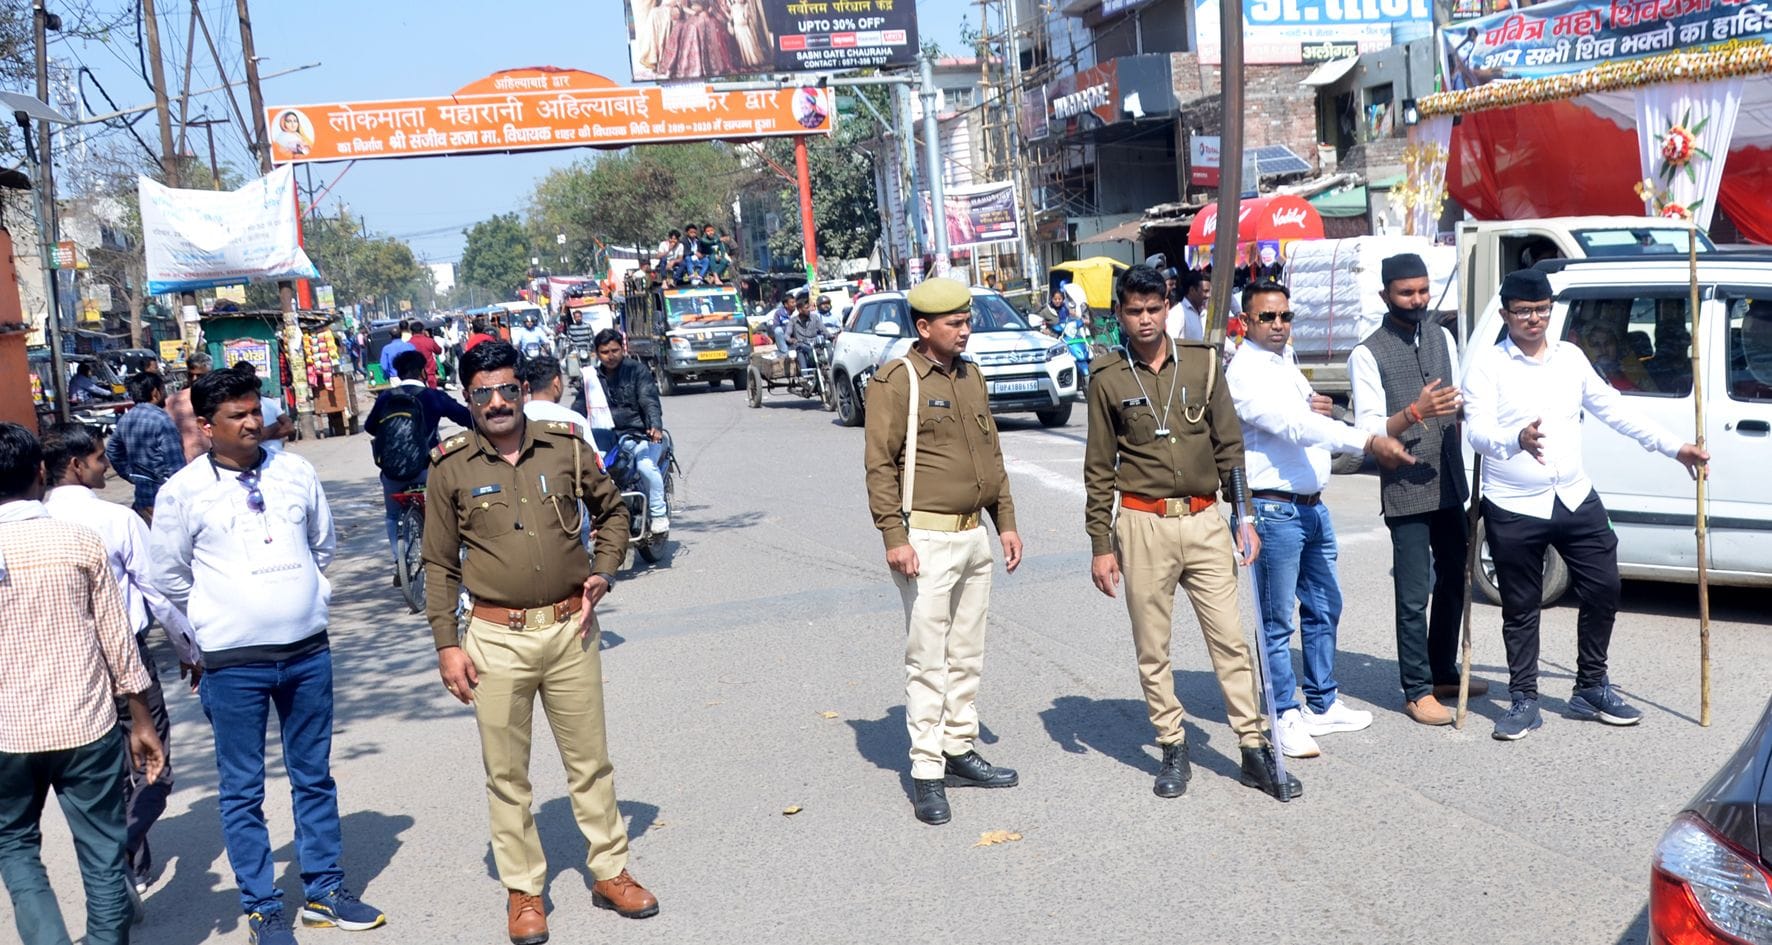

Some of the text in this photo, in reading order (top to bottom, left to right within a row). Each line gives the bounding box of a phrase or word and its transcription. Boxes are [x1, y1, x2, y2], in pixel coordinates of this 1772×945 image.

[798, 19, 830, 32] UPTO
[833, 19, 856, 31] 30%
[1485, 15, 1547, 47] पवित्र
[1553, 8, 1601, 37] महा
[823, 49, 845, 60] GATE
[847, 47, 894, 58] CHAURAHA
[1481, 49, 1519, 69] आप
[1525, 42, 1570, 66] सभी
[1575, 36, 1614, 62] शिव
[1679, 20, 1707, 44] का
[804, 59, 838, 68] CONTACT
[494, 75, 570, 90] अहिल्याबाई द्वार
[328, 104, 425, 132] लोकमाता
[438, 97, 523, 125] महारानी
[536, 89, 649, 120] अहिल्याबाई
[743, 89, 780, 110] द्वार
[337, 142, 352, 153] का
[353, 136, 383, 152] निर्माण
[389, 131, 406, 149] श्री
[409, 129, 447, 148] संजीव
[450, 131, 478, 146] राजा
[482, 131, 501, 144] मा.
[503, 124, 552, 142] विधायक
[555, 128, 576, 140] शहर
[578, 125, 590, 139] की
[592, 125, 628, 136] विधायक
[630, 121, 651, 135] निधि
[652, 119, 666, 134] वर्ष
[713, 119, 722, 132] में
